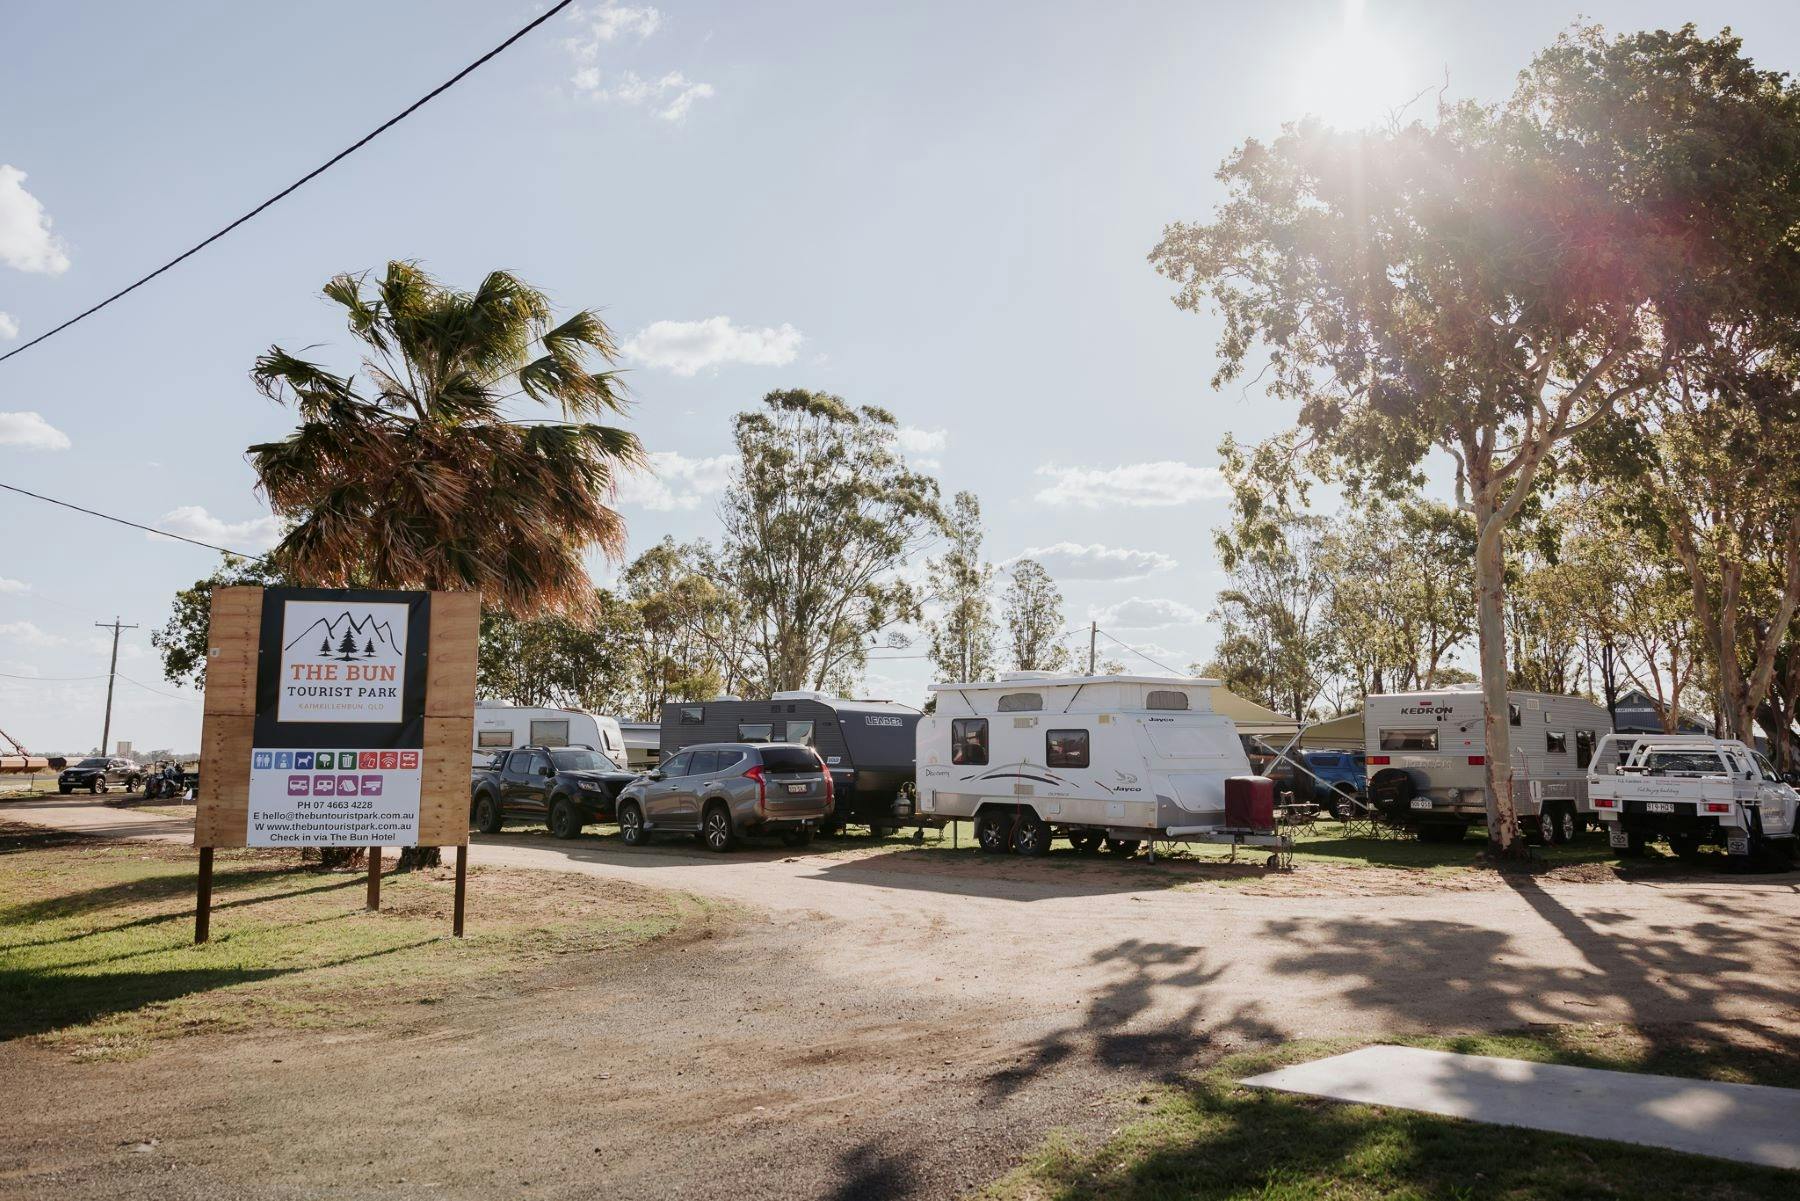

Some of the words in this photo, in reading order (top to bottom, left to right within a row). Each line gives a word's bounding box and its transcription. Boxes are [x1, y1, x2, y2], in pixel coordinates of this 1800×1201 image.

[291, 664, 338, 681] THE
[345, 664, 397, 682] BUN
[287, 686, 353, 697] TOURIST
[358, 687, 397, 698] PARK
[1401, 706, 1453, 715] KEDRON
[297, 801, 311, 809] PH
[313, 801, 325, 809] 07
[326, 801, 349, 809] 4663
[351, 801, 373, 809] 4228
[253, 812, 260, 820] E
[262, 811, 414, 821] hello@thebuntouristpark.com.au
[255, 823, 265, 831] W
[267, 822, 412, 832] www.thebuntouristpark.com.au
[270, 833, 300, 841] Check
[302, 833, 311, 841] in
[313, 833, 328, 841] via
[330, 833, 347, 841] The
[349, 833, 369, 841] Bun
[371, 832, 396, 841] Hotel
